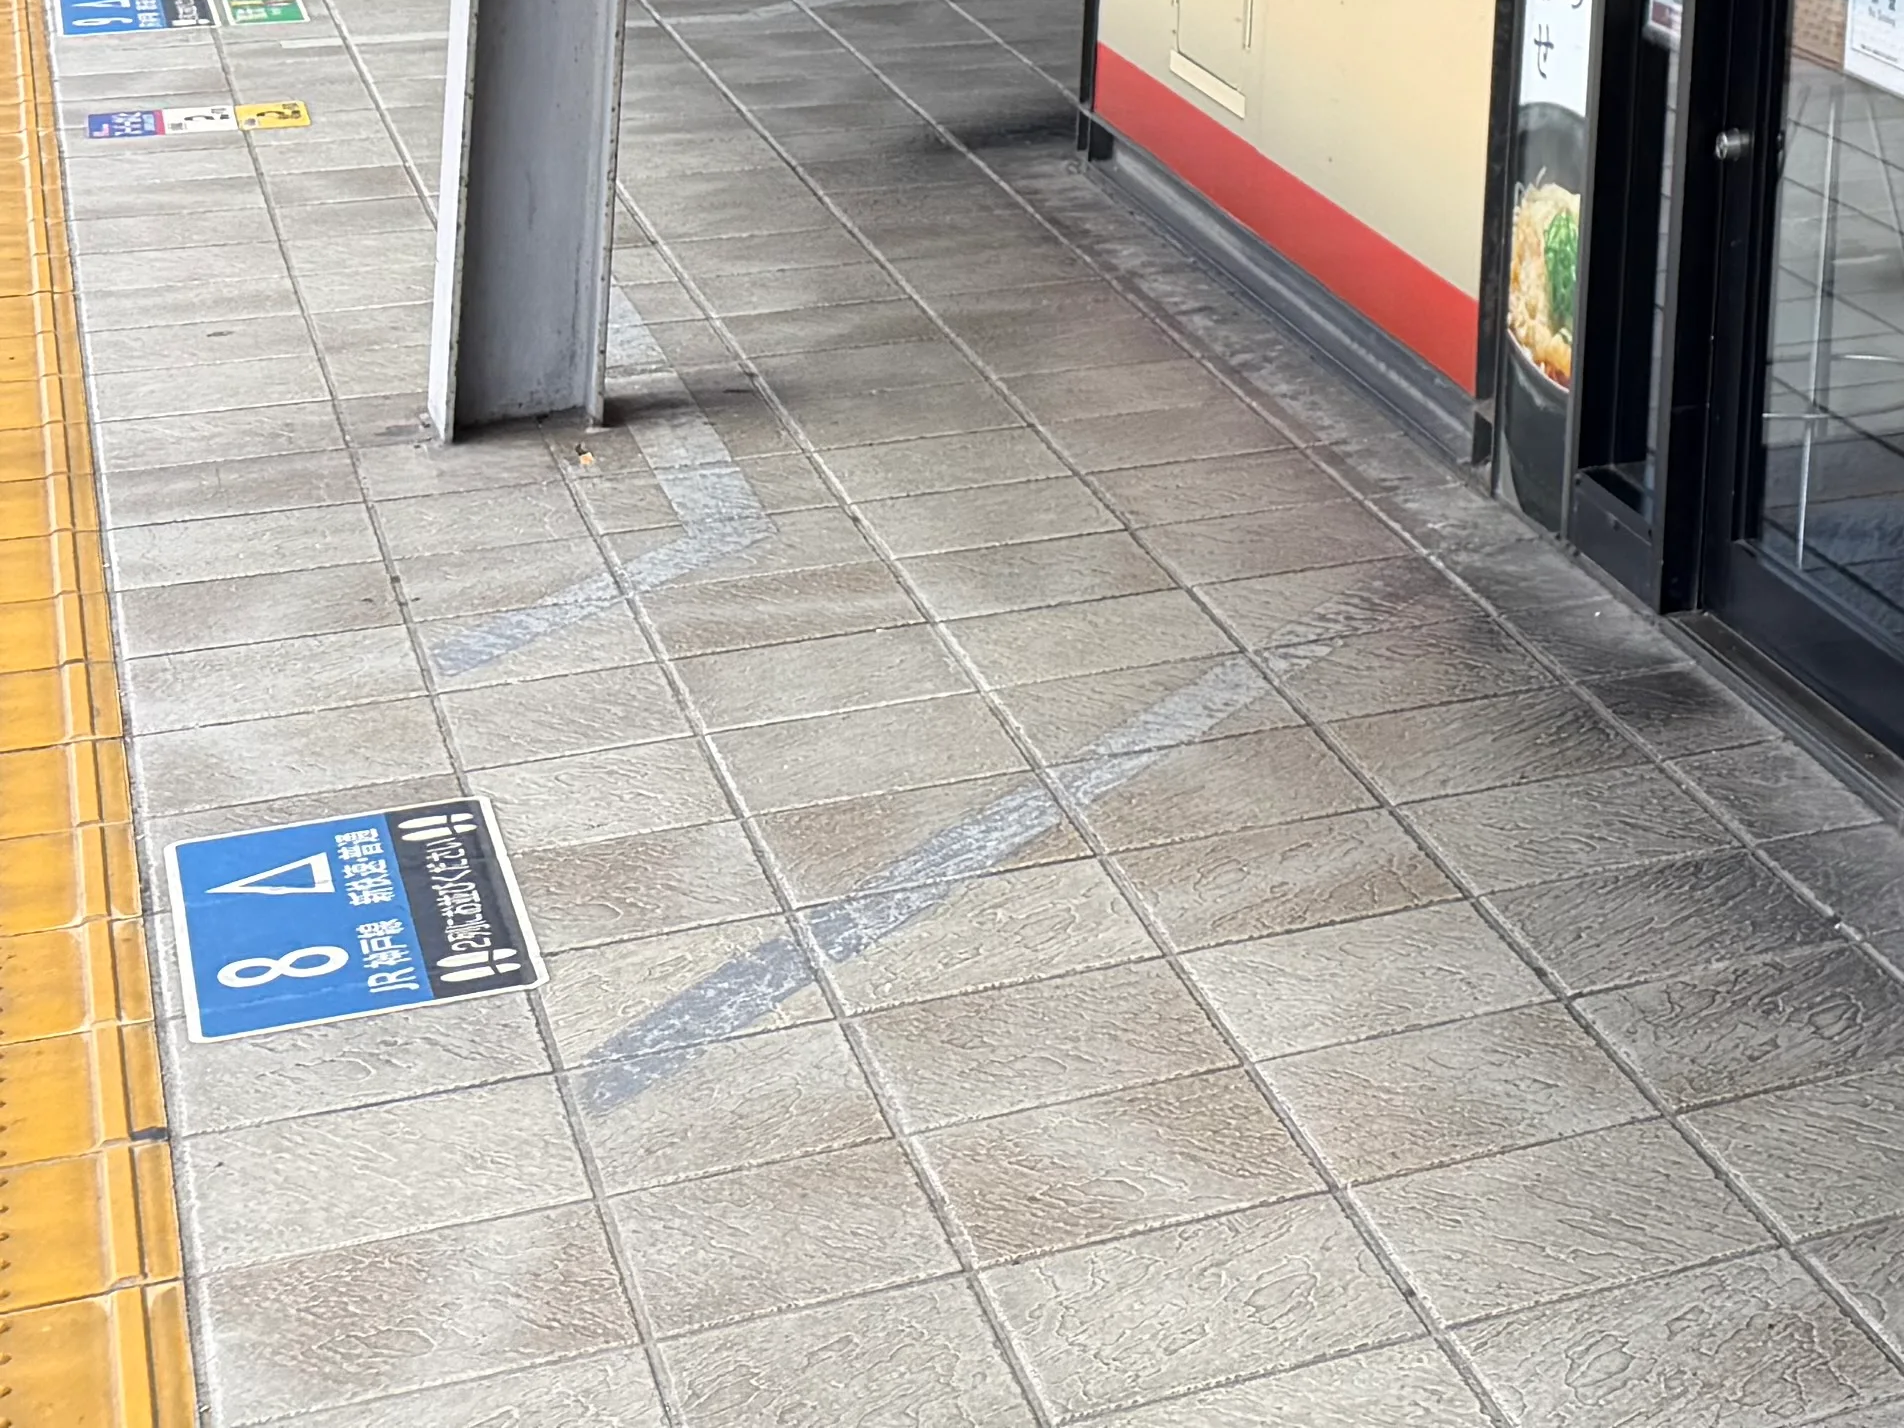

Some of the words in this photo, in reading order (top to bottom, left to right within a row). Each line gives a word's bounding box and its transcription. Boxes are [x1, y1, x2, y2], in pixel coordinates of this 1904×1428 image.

[335, 828, 395, 907] 新快速・普通
[426, 835, 492, 952] 2列にお並びください
[217, 945, 349, 988] 8
